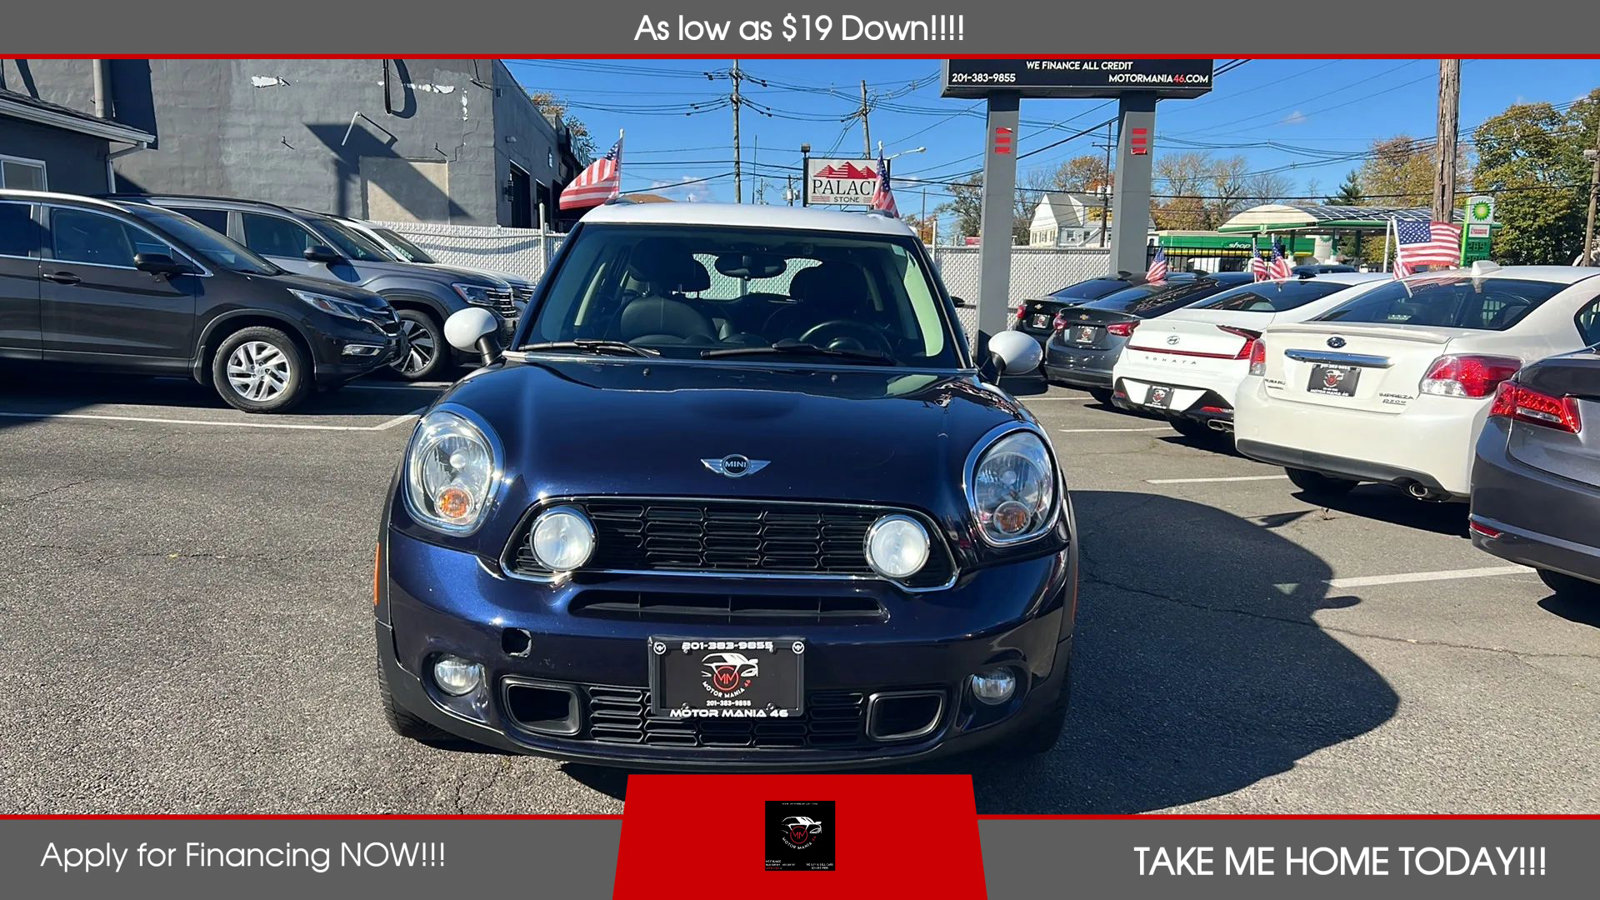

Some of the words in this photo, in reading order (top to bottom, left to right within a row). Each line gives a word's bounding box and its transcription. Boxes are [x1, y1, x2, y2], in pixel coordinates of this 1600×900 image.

[1026, 61, 1040, 70] WE
[1042, 61, 1080, 70] FINANCE
[1082, 61, 1099, 70] ALL
[1101, 61, 1133, 70] CREDIT
[951, 73, 1016, 83] 201-383-9855
[1108, 74, 1209, 83] MOTORMANIA46.COM
[1145, 355, 1197, 366] SONATA
[682, 641, 773, 652] 201-383-9855
[702, 681, 723, 698] MOTOR
[724, 687, 745, 698] MANIA
[670, 709, 718, 718] MOTOR
[721, 709, 767, 718] MANIA
[769, 709, 788, 718] 46
